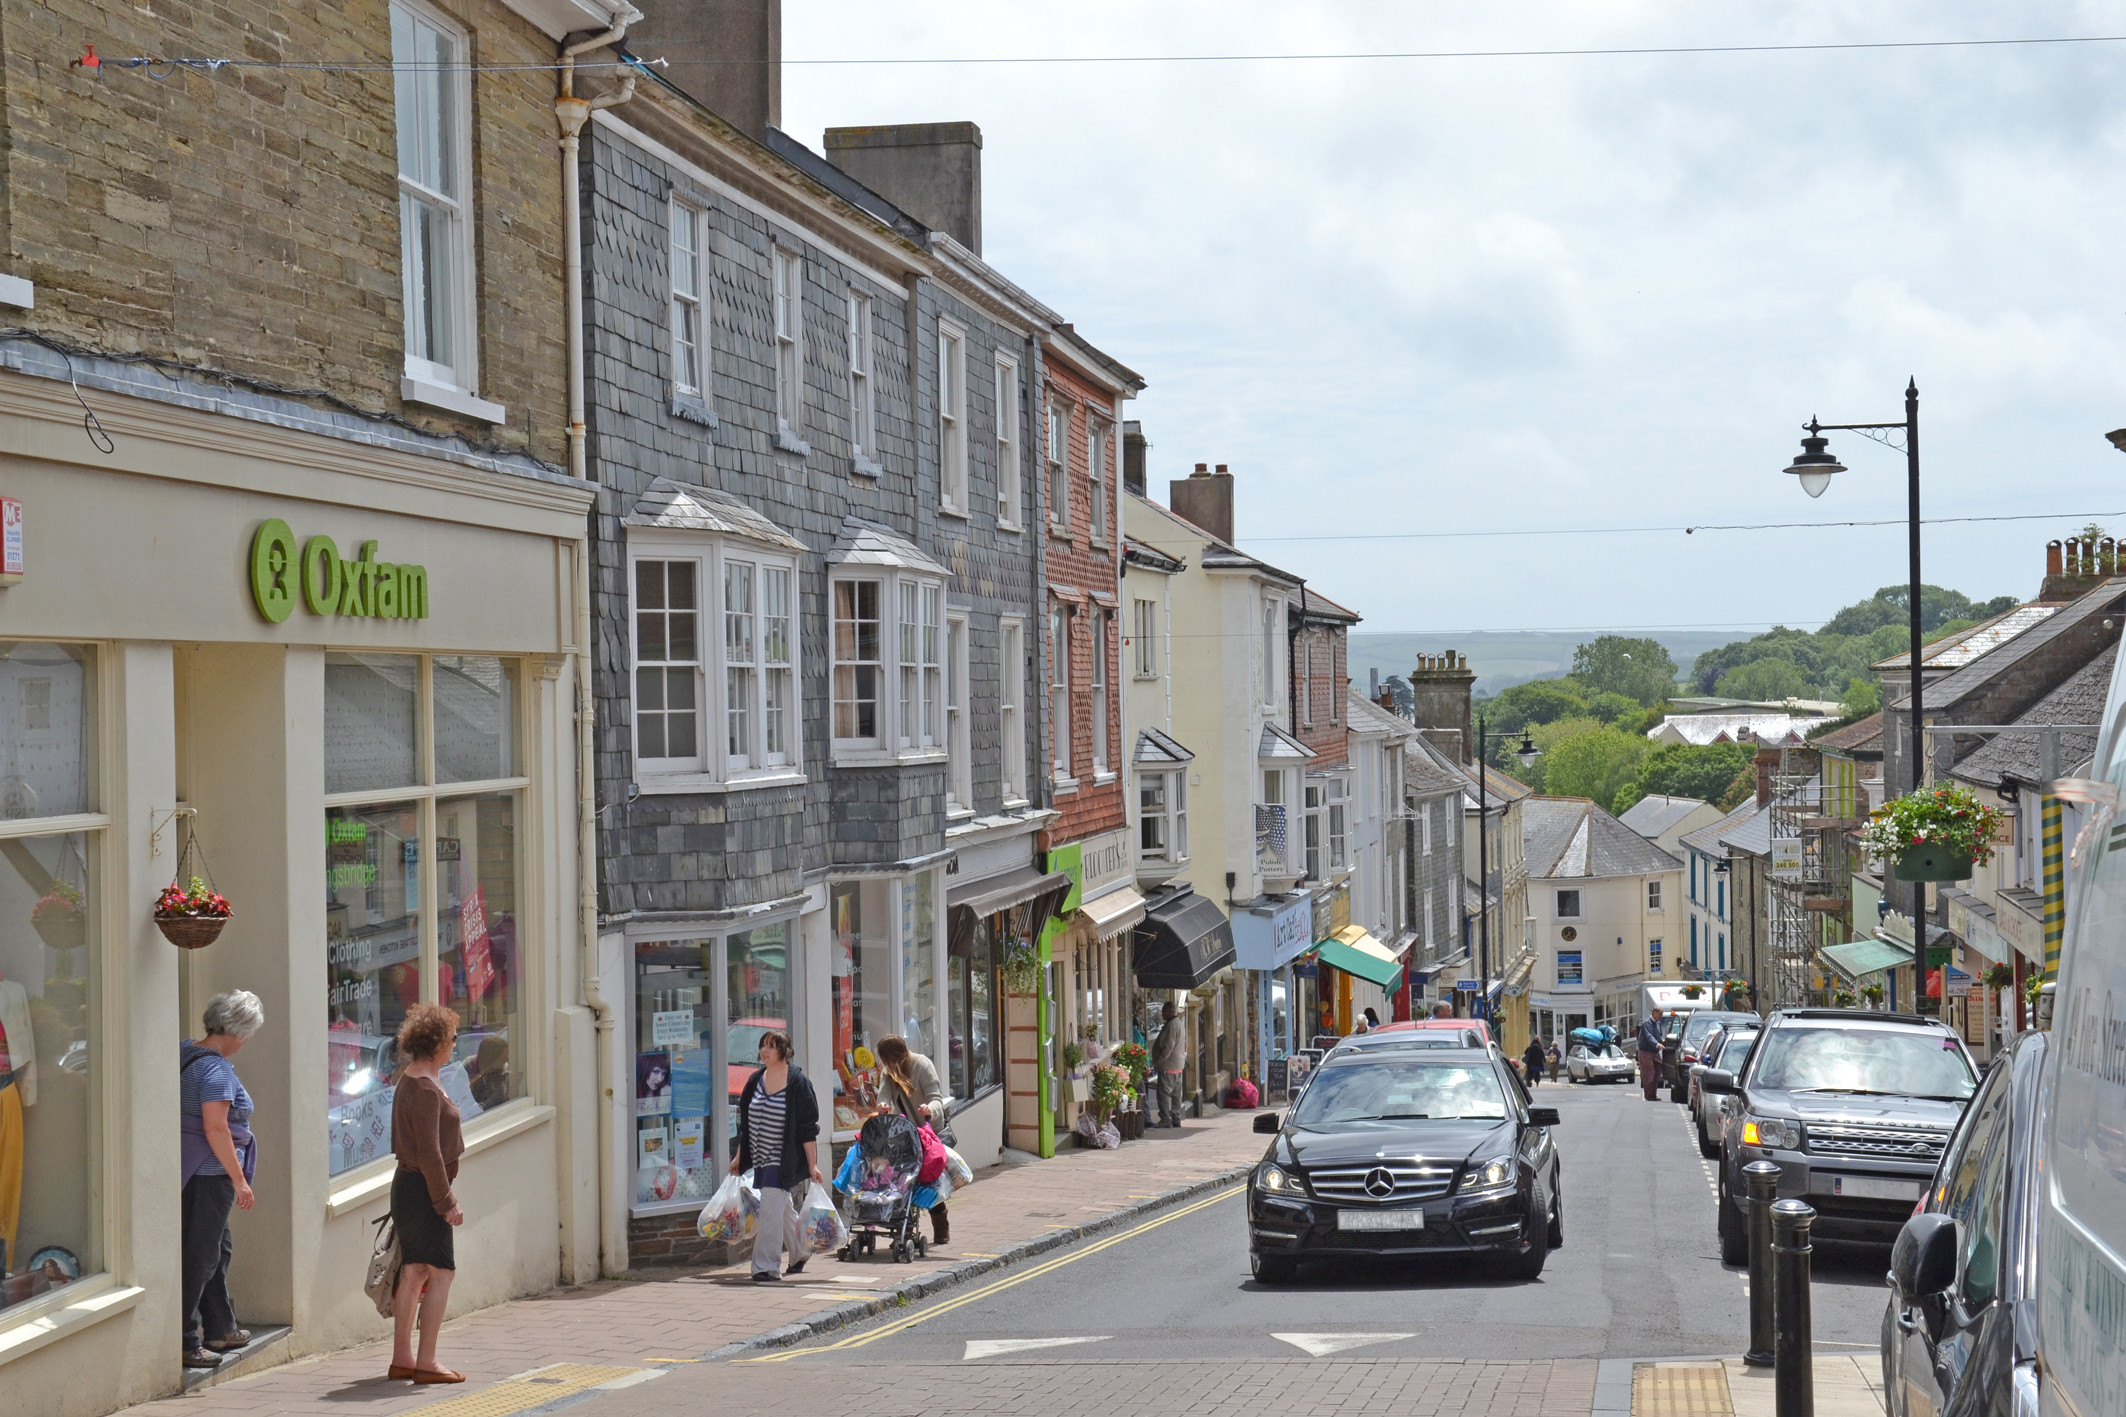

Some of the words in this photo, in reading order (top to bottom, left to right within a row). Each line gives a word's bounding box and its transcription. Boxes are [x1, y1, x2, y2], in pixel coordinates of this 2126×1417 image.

[303, 534, 428, 619] Oxfam
[332, 817, 366, 842] Oxfam
[1258, 866, 1284, 874] Pottery
[1260, 858, 1282, 866] Polish
[326, 860, 375, 893] ngsbridge
[463, 894, 480, 921] SYRIA
[464, 907, 482, 937] CRISIS
[328, 936, 372, 964] Clothing
[465, 920, 487, 953] APPEAL
[341, 1100, 374, 1123] Books
